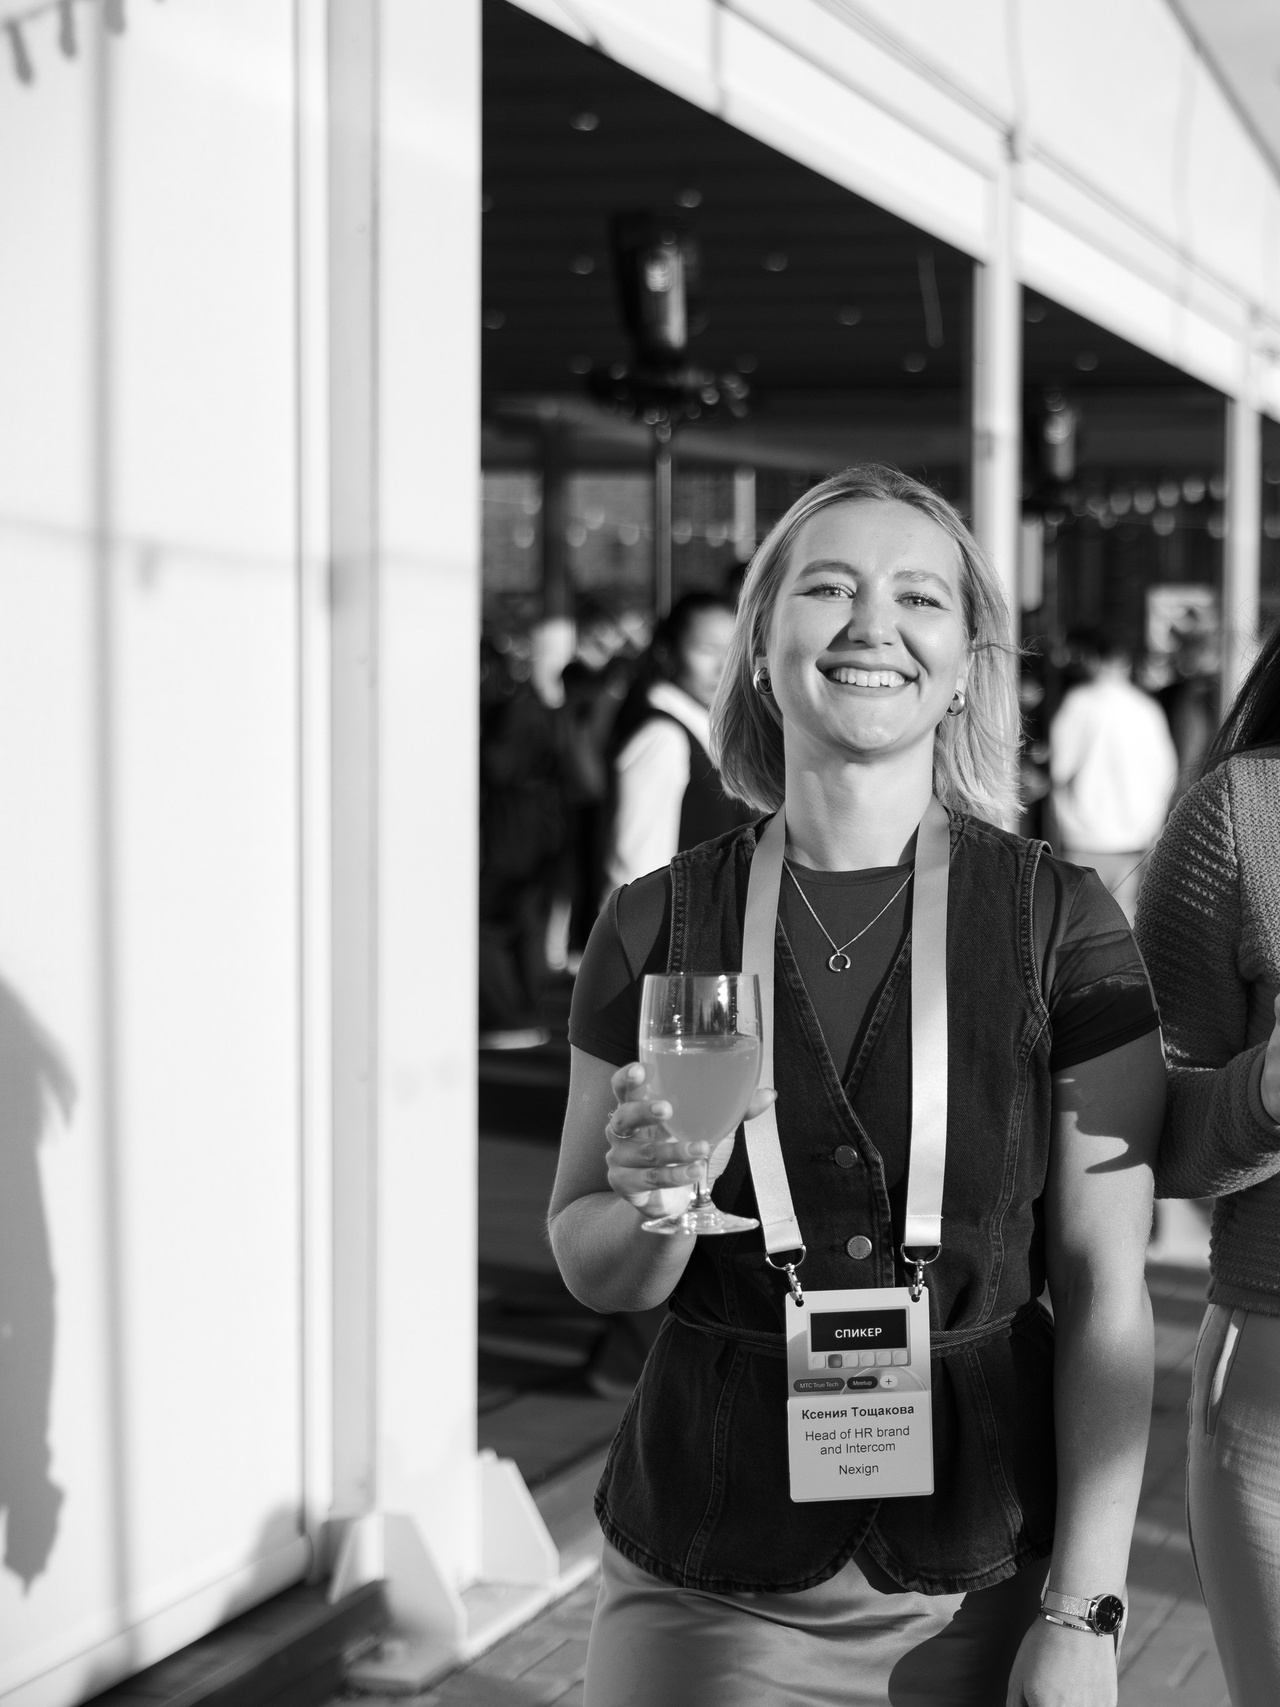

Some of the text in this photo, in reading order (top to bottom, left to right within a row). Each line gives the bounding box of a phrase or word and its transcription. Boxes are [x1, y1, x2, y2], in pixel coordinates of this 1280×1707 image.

[835, 1327, 882, 1338] СПИКЕР
[802, 1406, 914, 1420] Ксения Тощакова
[805, 1426, 910, 1441] Head of HR brand
[820, 1441, 896, 1455] and Intercom
[839, 1464, 879, 1476] Nexign
